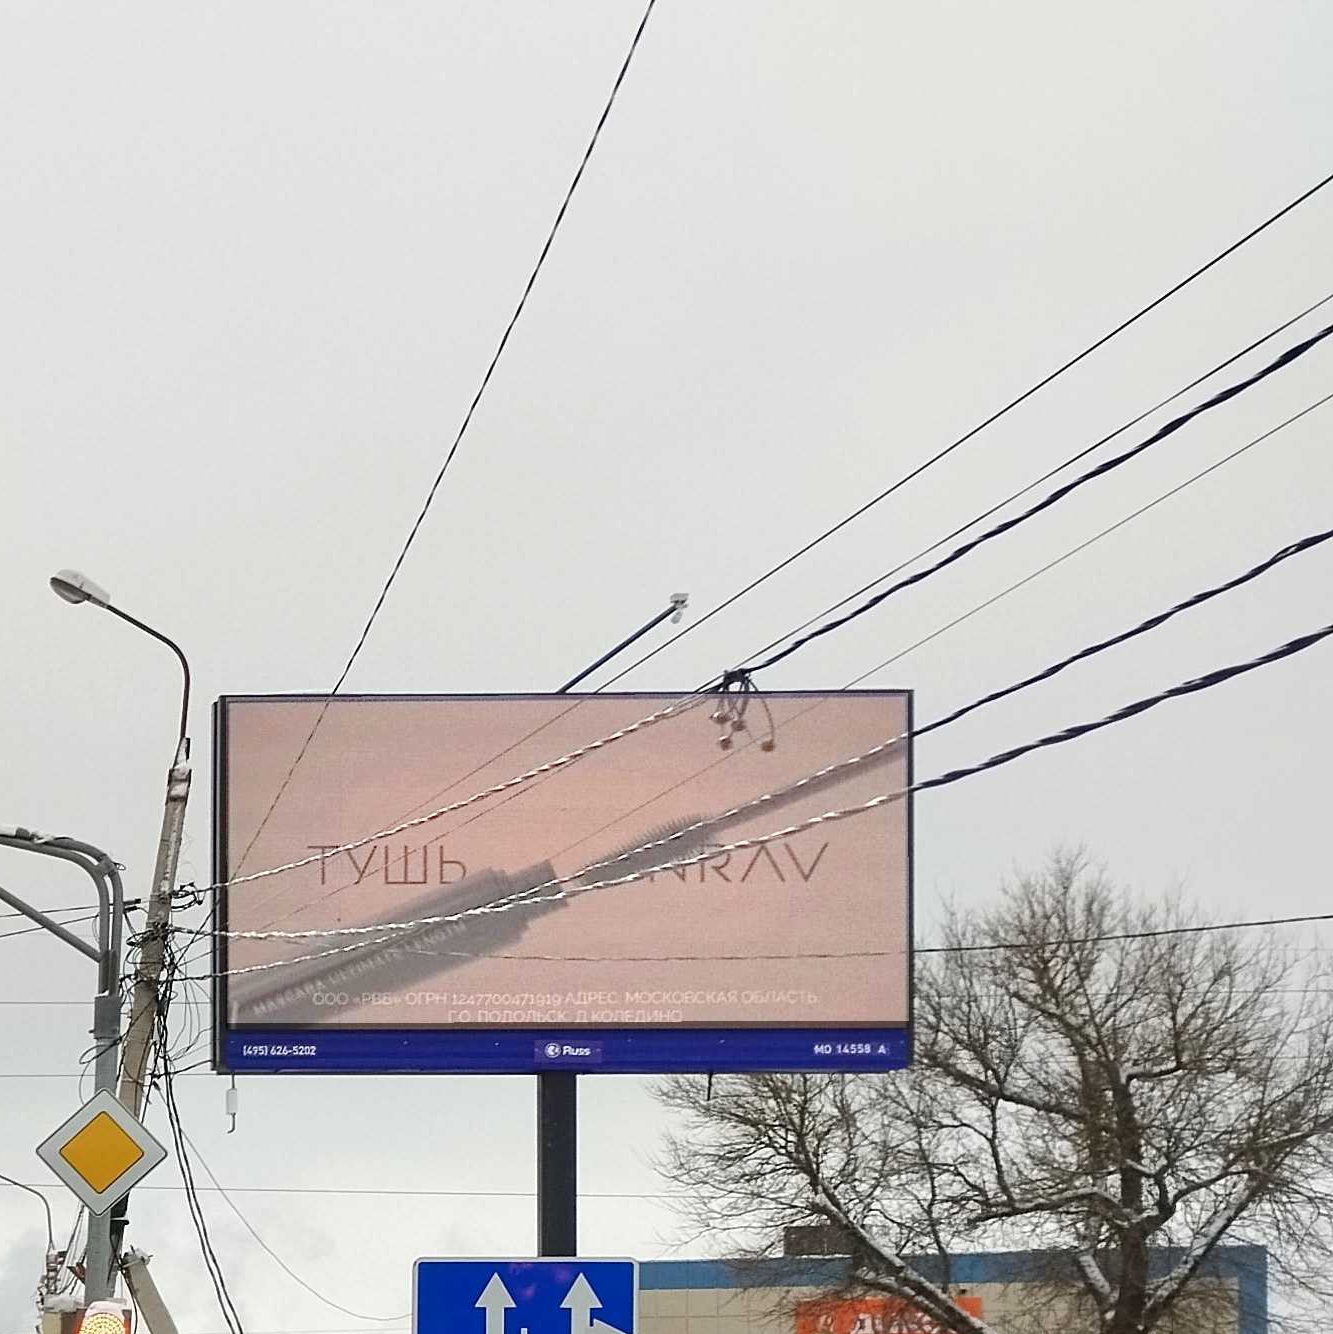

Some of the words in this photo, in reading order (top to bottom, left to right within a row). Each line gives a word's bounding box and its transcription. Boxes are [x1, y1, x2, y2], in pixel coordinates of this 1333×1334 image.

[307, 844, 466, 885] ТУШЬ
[312, 991, 350, 1006] ООО
[405, 991, 448, 1005] ОГРН
[625, 990, 738, 1005] МОСКОВСКАЯ
[270, 1045, 317, 1056] 626-5202
[562, 1045, 591, 1056] Russ
